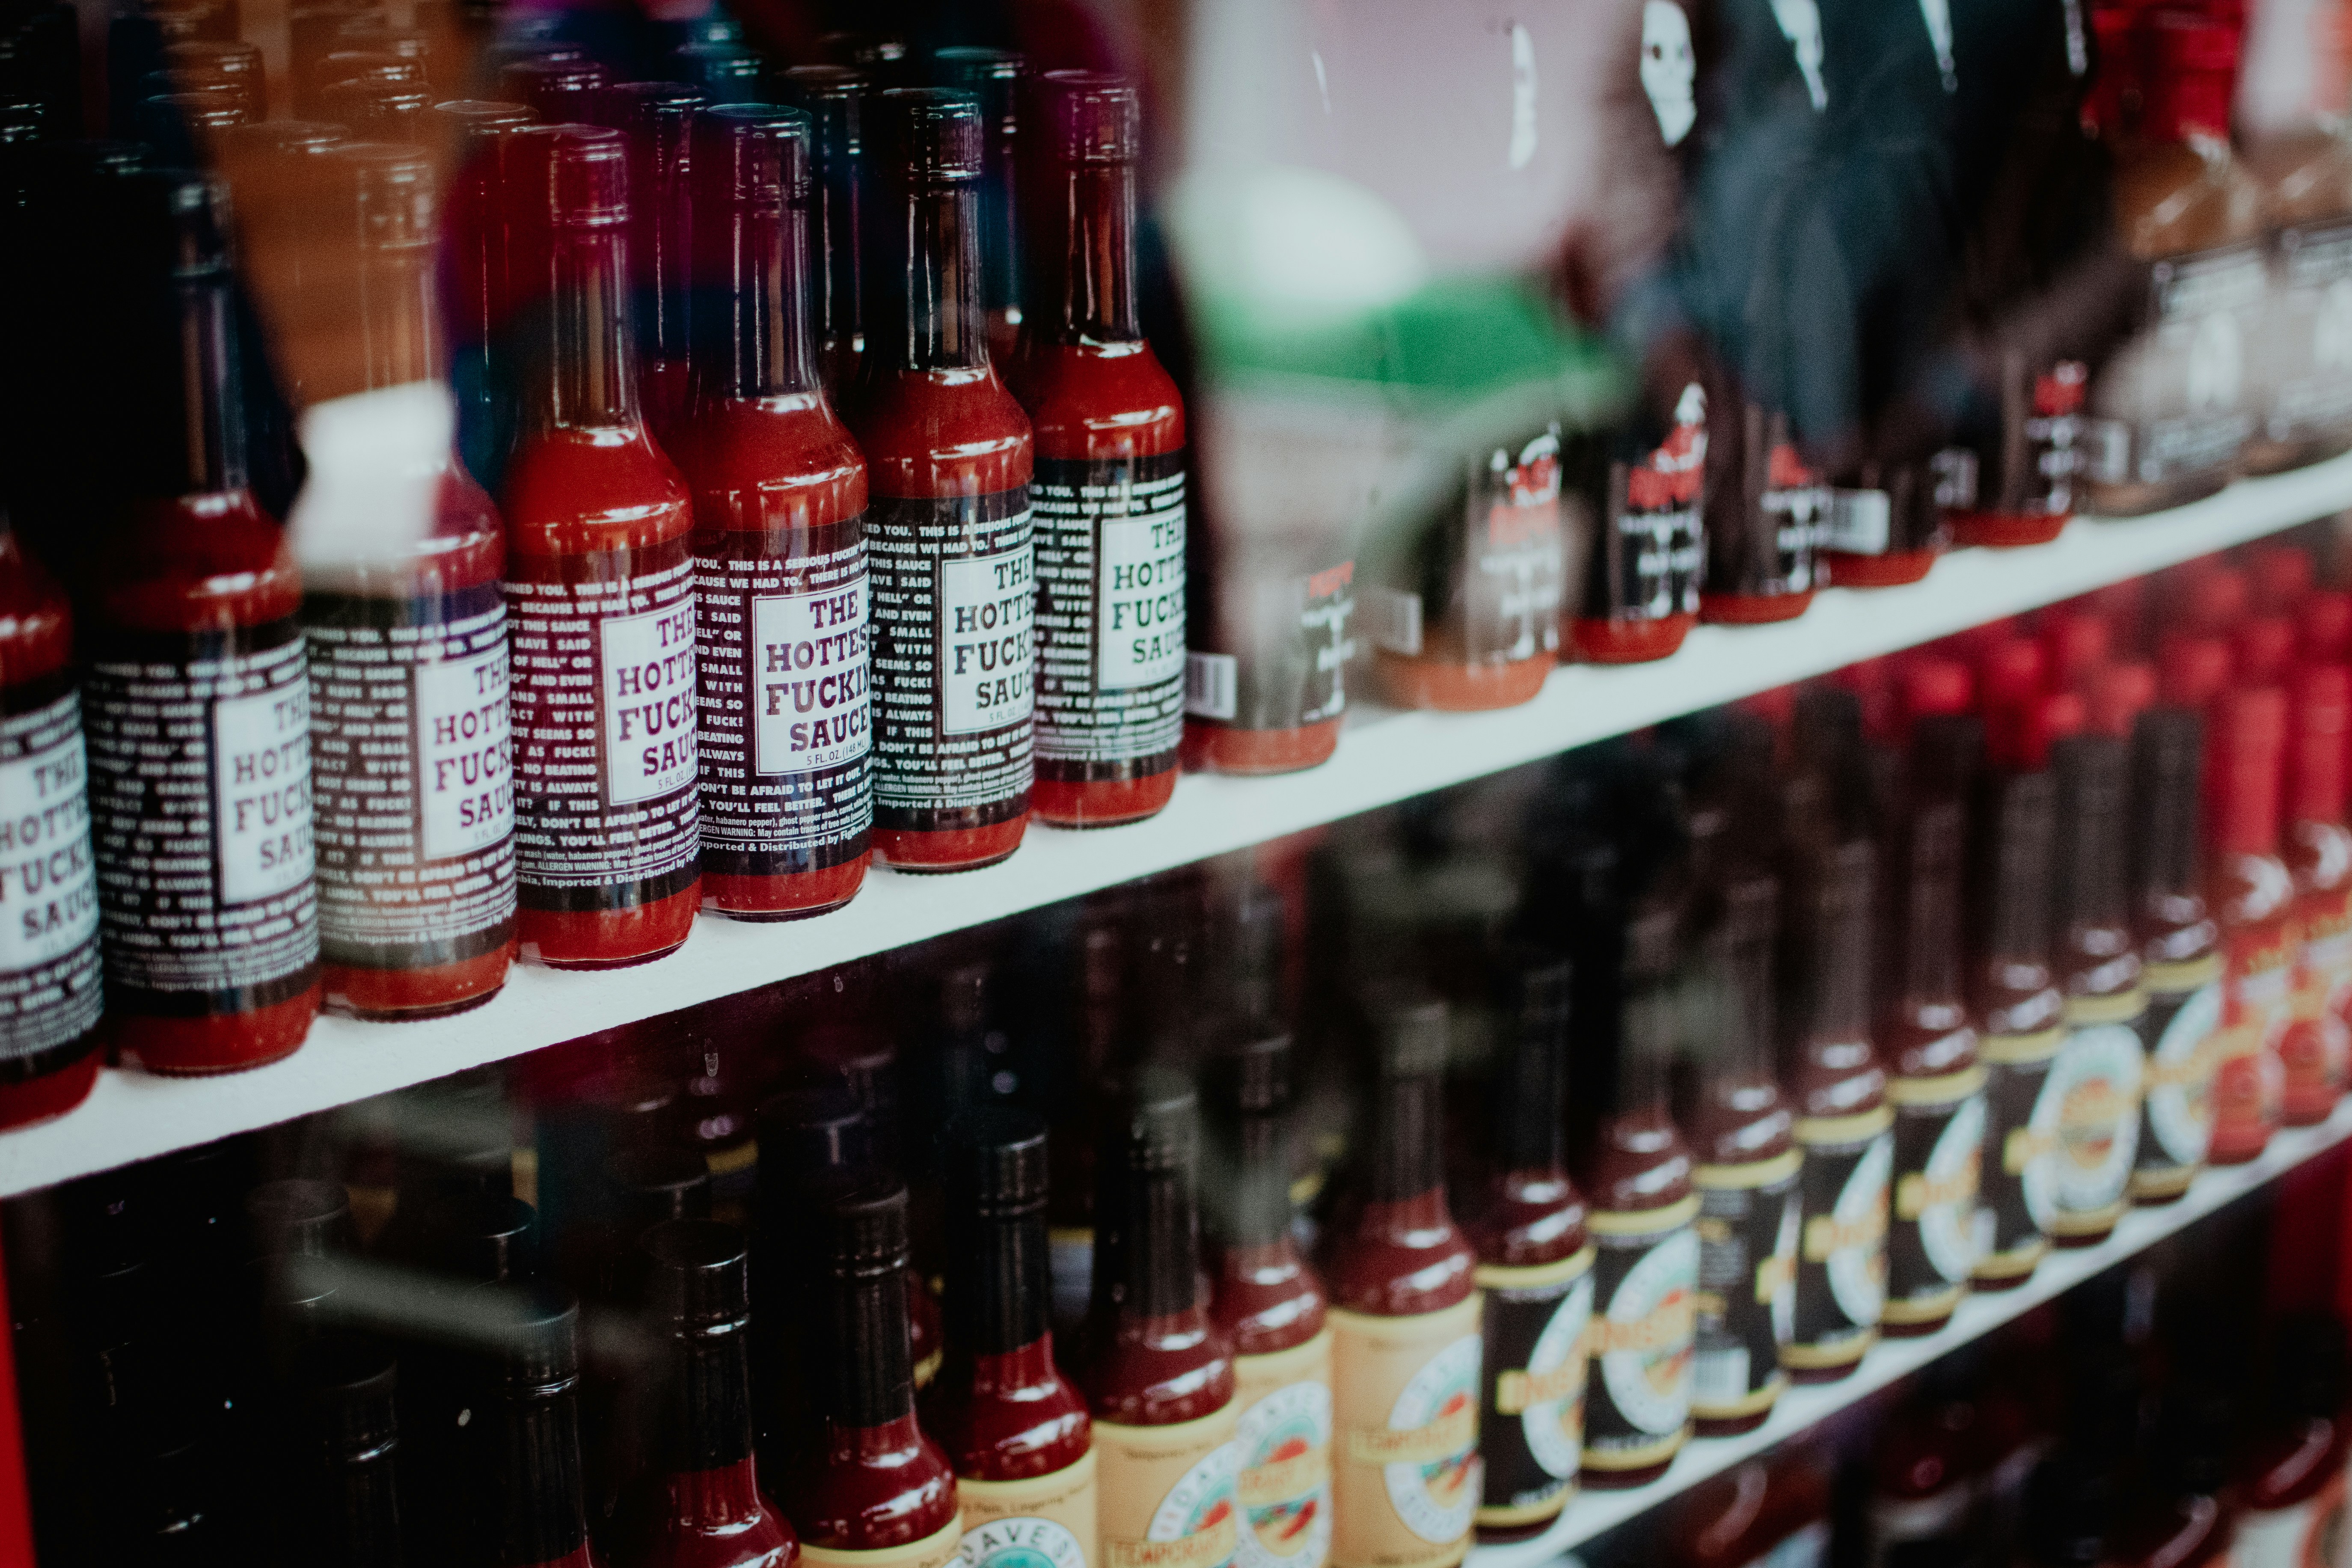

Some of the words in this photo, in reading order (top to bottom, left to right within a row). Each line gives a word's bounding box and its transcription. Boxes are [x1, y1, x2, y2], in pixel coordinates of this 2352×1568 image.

[884, 526, 912, 536] YOU.
[919, 526, 945, 537] THIS
[947, 526, 959, 536] IS
[694, 558, 721, 570] YOU.
[728, 560, 754, 570] THIS
[758, 561, 770, 570] IS
[772, 560, 782, 570] A
[786, 554, 830, 569] SERIOUS
[832, 543, 859, 563] FUCKIN'
[895, 560, 932, 571] SAUCE
[694, 575, 726, 587] CAUSE
[729, 578, 749, 588] WE
[753, 578, 779, 588] HAD
[783, 576, 802, 587] TO.
[810, 569, 839, 584] THERE
[841, 566, 848, 577] IS
[849, 562, 859, 574] NO
[901, 577, 932, 588] SAID
[537, 584, 568, 596] YOU.
[694, 593, 703, 603] IS
[706, 594, 741, 606] SAUCE
[877, 592, 909, 603] HELL"
[914, 594, 932, 604] OR
[521, 601, 573, 614] BECAUSE
[809, 589, 858, 630] THE
[711, 612, 741, 623] SAID
[902, 611, 932, 621] EVEN
[696, 628, 719, 638] ELL"
[724, 630, 742, 641] OR
[889, 627, 932, 638] SMALL
[515, 637, 548, 650] HAVE
[557, 638, 591, 650] SAID
[766, 622, 868, 672] HOTTES
[894, 643, 932, 654] WITH
[694, 644, 710, 655] ND
[713, 647, 742, 658] EVEN
[954, 631, 1031, 675] FUCK
[701, 663, 742, 675] SMALL
[530, 675, 557, 686] AND
[559, 674, 593, 686] EVEN
[705, 680, 742, 692] WITH
[894, 677, 932, 688] FUCK!
[511, 691, 537, 703] AND
[547, 692, 594, 704] SMALL
[695, 696, 722, 709] EEMS
[727, 700, 743, 710] SO
[885, 692, 932, 704] BEATING
[552, 711, 594, 722] WITH
[618, 684, 697, 742] FUCK
[707, 714, 743, 727] FUCK!
[790, 703, 868, 752] SAUCE
[697, 731, 744, 744] BEATING
[528, 746, 545, 757] AS
[555, 746, 596, 758] FUCK!
[698, 748, 745, 761] ALWAYS
[807, 755, 812, 766] 5
[815, 754, 827, 764] FL.
[829, 750, 841, 761] OZ.
[523, 763, 541, 775] NO
[544, 764, 597, 775] BEATING
[700, 765, 710, 775] IF
[717, 767, 745, 778] THIS
[530, 781, 542, 792] IS
[546, 782, 598, 793] ALWAYS
[658, 779, 663, 790] 5
[732, 785, 746, 795] BE
[750, 784, 794, 796] AFRAID
[798, 782, 814, 793] TO
[817, 777, 833, 790] LET
[836, 774, 844, 785] IT
[709, 800, 750, 813] YOU'LL
[754, 802, 781, 813] FEEL
[784, 797, 826, 811] BETTER.
[833, 786, 856, 803] THERE
[857, 781, 864, 793] IS
[548, 800, 561, 811] IF
[568, 800, 599, 811] THIS
[540, 817, 581, 829] DON'T
[584, 817, 601, 829] BE
[604, 810, 648, 827] AFRAID
[650, 806, 665, 819] TO
[666, 799, 680, 814] LET
[716, 815, 747, 826] habanero
[748, 817, 778, 828] pepper),
[779, 816, 798, 827] ghost
[799, 813, 821, 825] pepper
[559, 834, 606, 846] YOU'LL
[609, 831, 636, 844] FEEL
[639, 820, 676, 840] BETTER.
[699, 824, 720, 834] ERGEN
[721, 827, 756, 837] WARNING:
[758, 829, 772, 838] May
[773, 827, 799, 836] contain
[800, 824, 820, 834] traces
[821, 821, 828, 830] of
[829, 820, 840, 828] tree
[699, 840, 745, 852] mported
[748, 843, 757, 852] &
[760, 836, 826, 852] Distributed
[828, 835, 839, 845] by
[542, 876, 601, 889] Imported
[604, 875, 614, 885] &
[615, 861, 676, 884] Distributed
[677, 858, 686, 868] by
